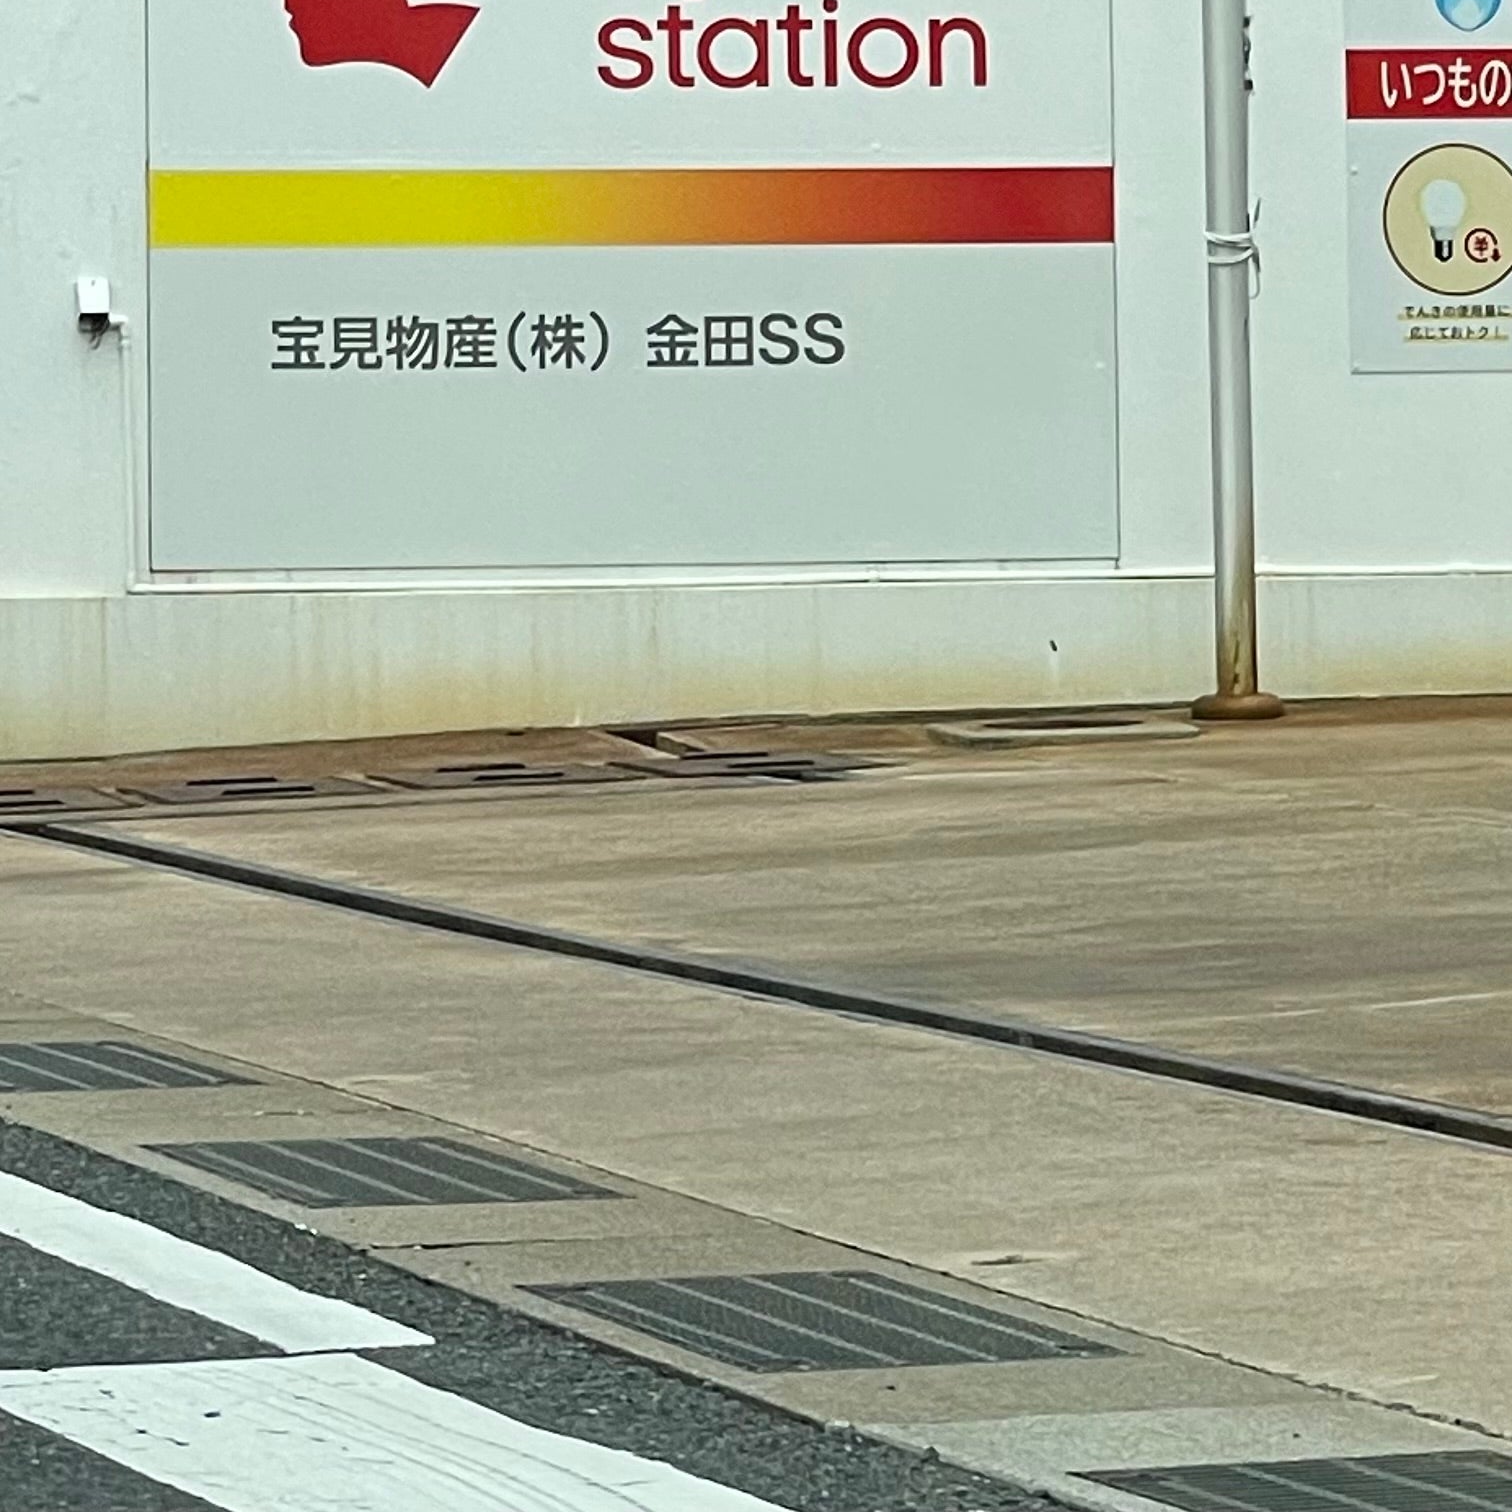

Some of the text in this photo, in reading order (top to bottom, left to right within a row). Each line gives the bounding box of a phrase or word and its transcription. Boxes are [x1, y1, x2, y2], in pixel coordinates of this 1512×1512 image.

[270, 310, 846, 374] 宝見物産（株） 金田SS
